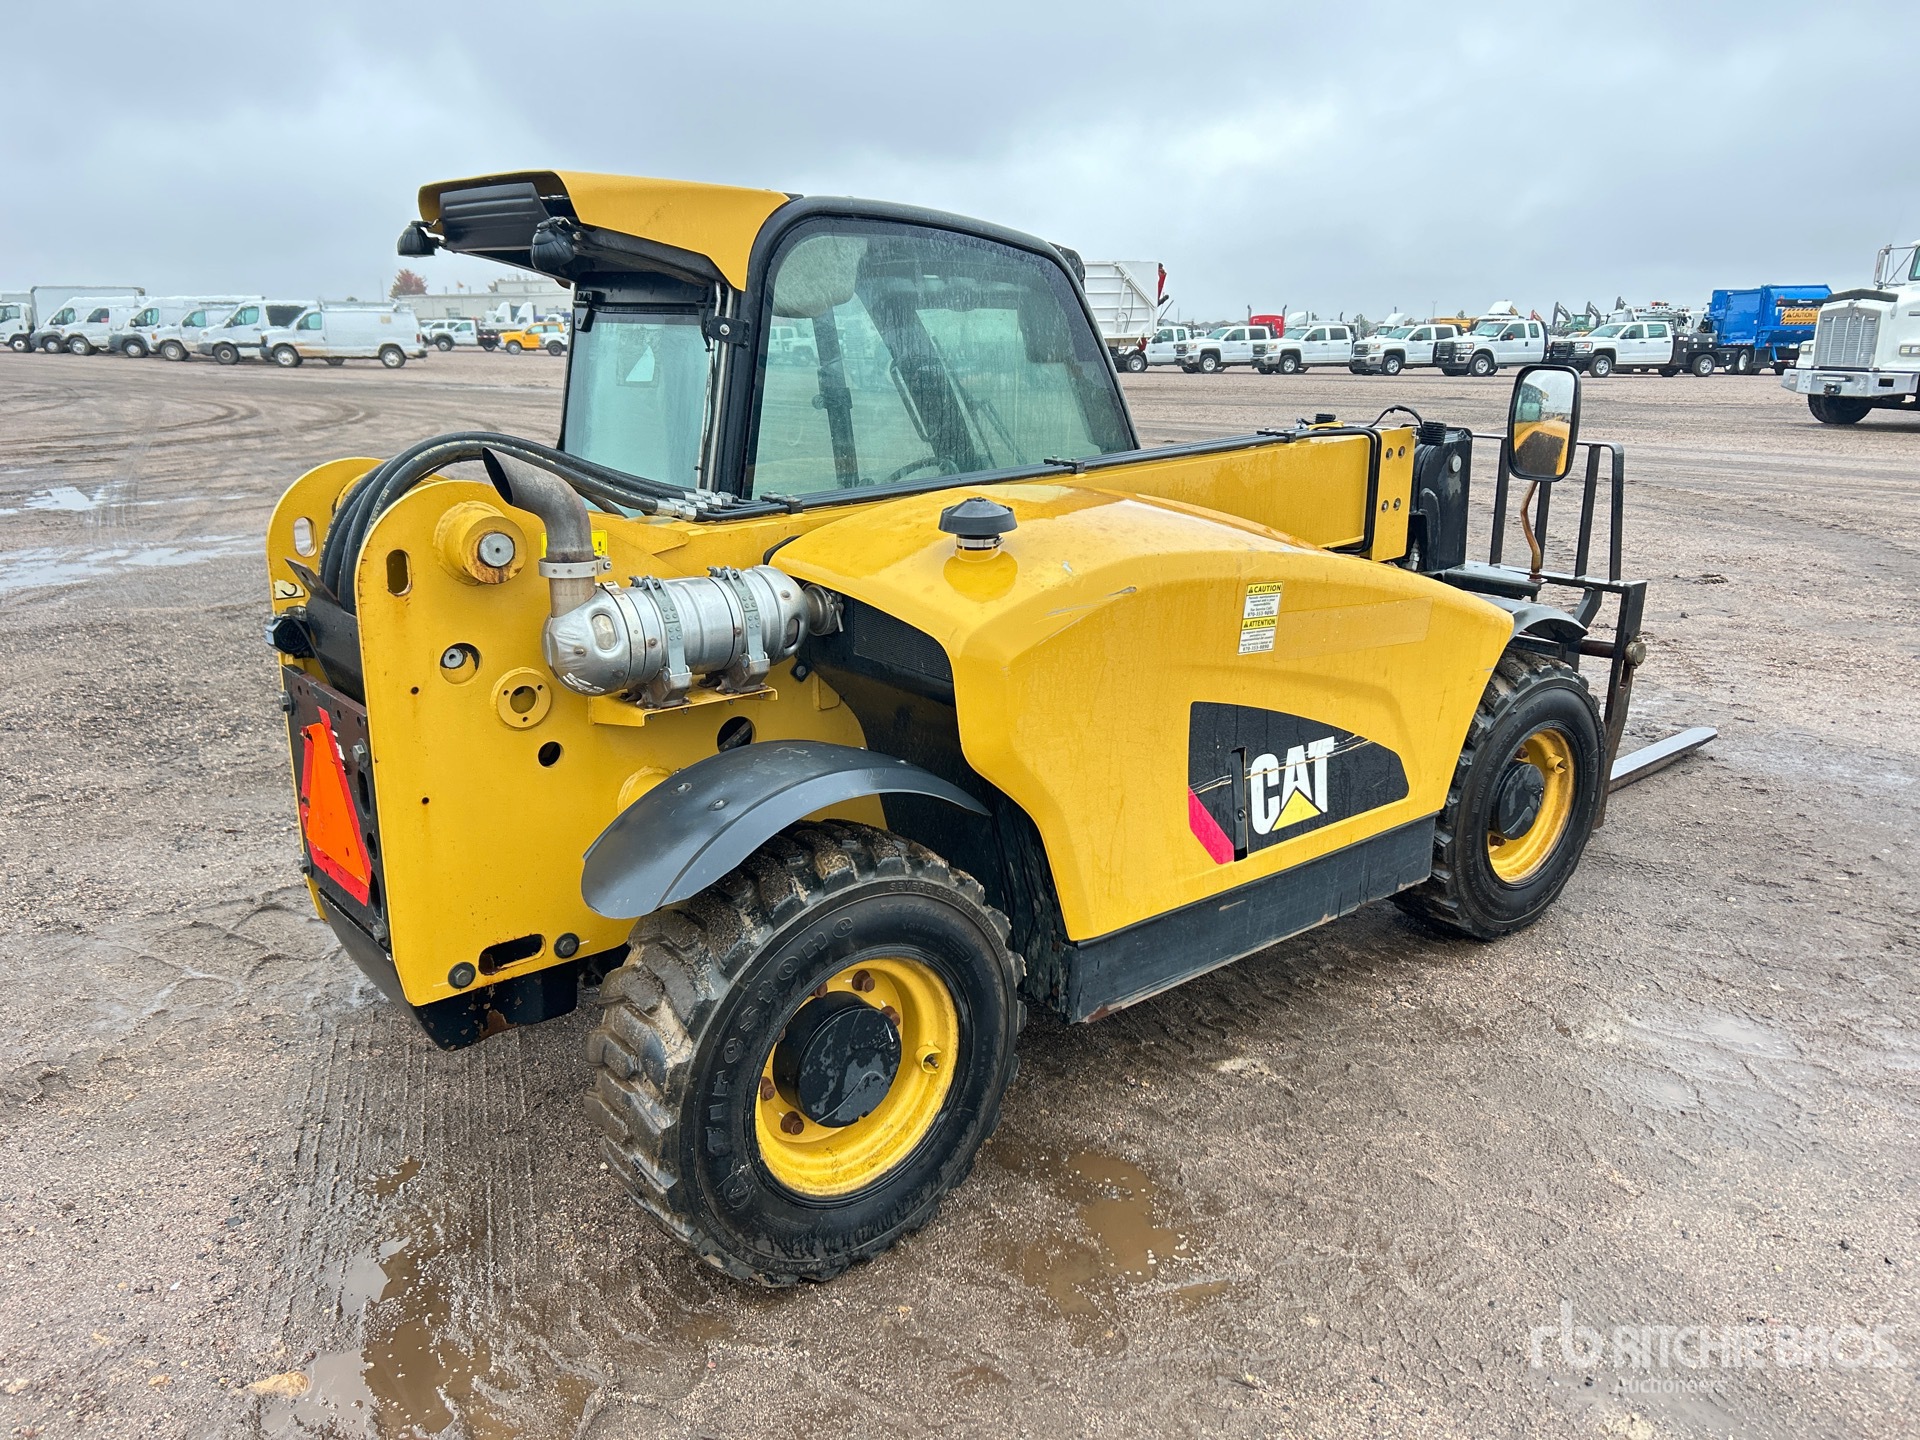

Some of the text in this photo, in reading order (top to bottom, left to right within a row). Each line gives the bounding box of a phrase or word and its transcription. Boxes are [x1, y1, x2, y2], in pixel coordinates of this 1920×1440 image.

[1254, 584, 1281, 593] CAUTION
[1248, 618, 1276, 627] ATTENTION
[1250, 736, 1335, 835] CAT
